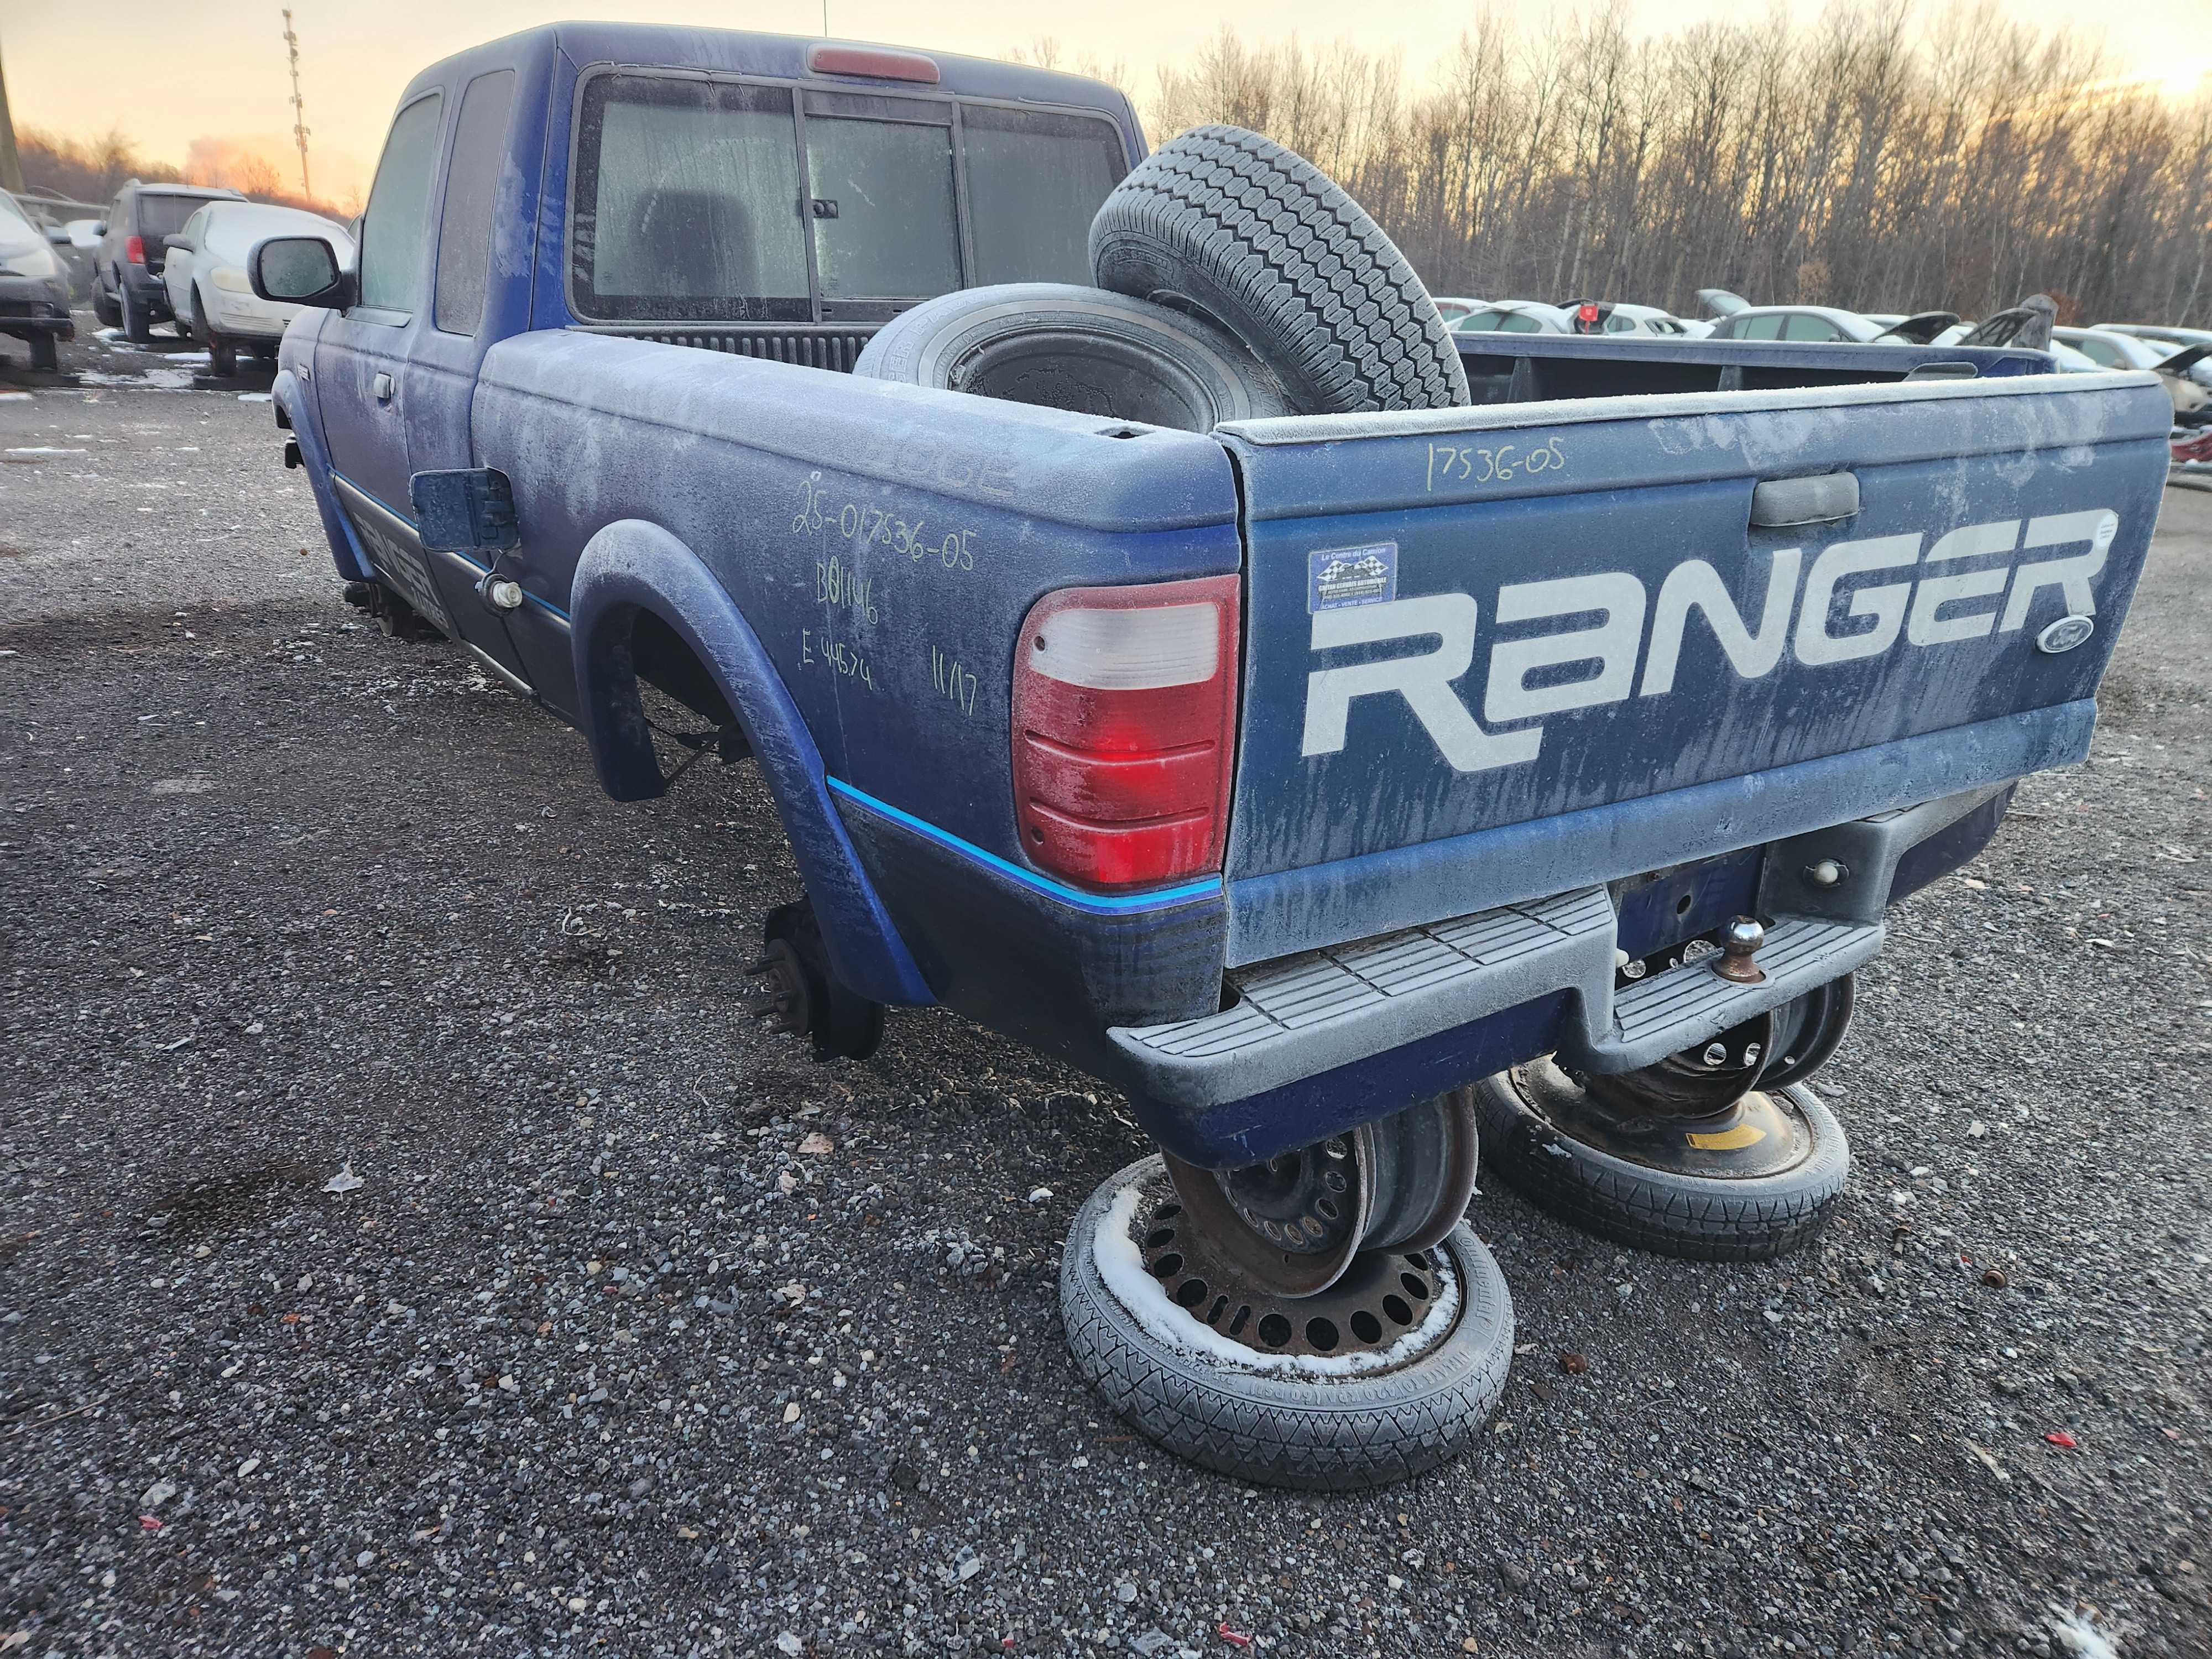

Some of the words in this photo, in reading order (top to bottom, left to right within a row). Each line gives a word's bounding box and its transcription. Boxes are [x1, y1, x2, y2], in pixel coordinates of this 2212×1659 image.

[1427, 436, 1564, 491] 17536-05
[353, 513, 441, 606] RANGER
[792, 480, 977, 571] 25-017536-05
[1302, 509, 2118, 772] RANGER
